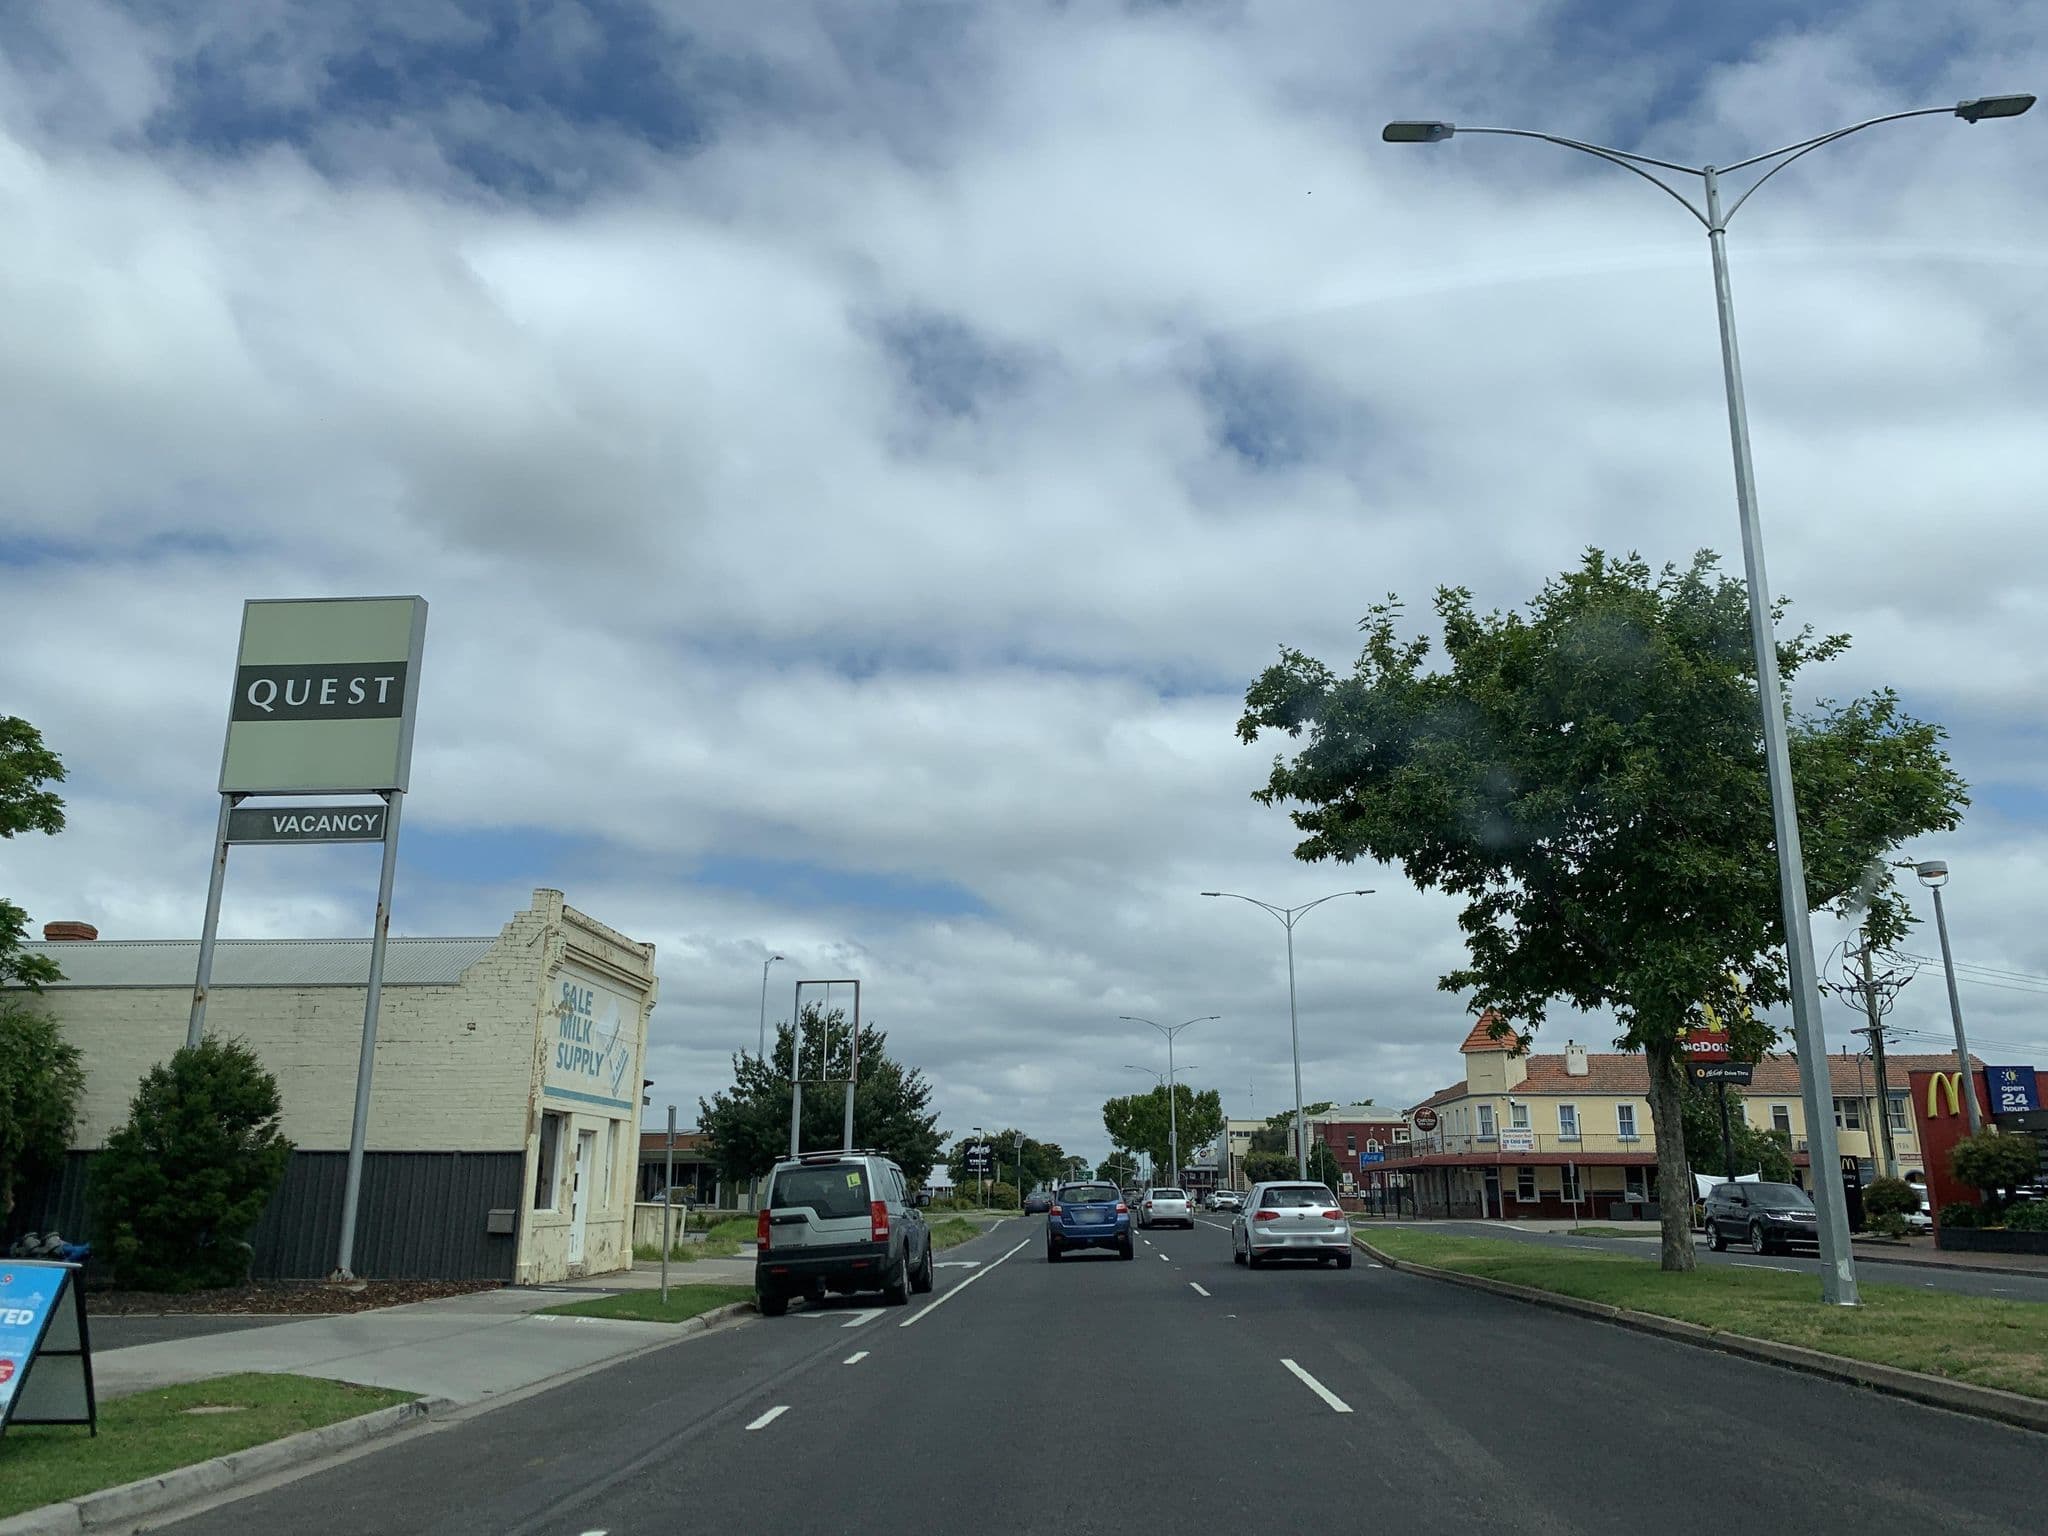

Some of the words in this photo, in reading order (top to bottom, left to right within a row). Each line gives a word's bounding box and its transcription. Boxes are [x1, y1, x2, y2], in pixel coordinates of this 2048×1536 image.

[247, 676, 395, 713] QUEST
[272, 814, 379, 833] VACANCY
[562, 981, 594, 1016] SALE
[560, 1012, 593, 1044] MILK
[556, 1042, 605, 1077] SUPPLY
[2001, 1085, 2025, 1093] open
[2001, 1093, 2029, 1105] 24
